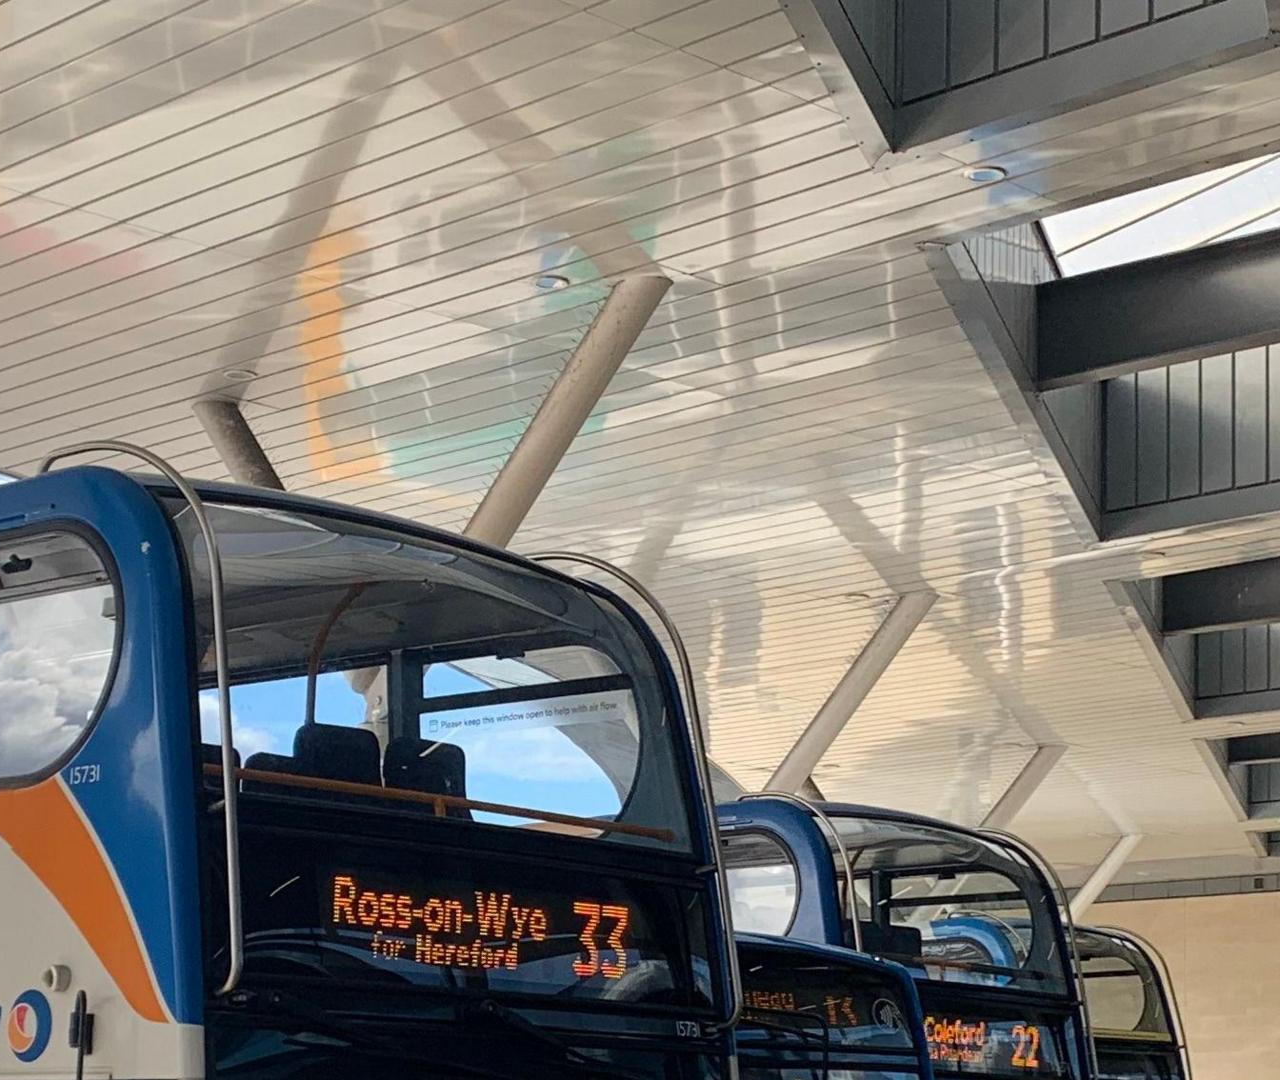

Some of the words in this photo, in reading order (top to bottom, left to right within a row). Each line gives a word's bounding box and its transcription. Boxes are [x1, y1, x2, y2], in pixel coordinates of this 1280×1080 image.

[464, 717, 481, 727] keep
[482, 715, 495, 725] this
[496, 711, 525, 723] window
[525, 710, 544, 721] open
[545, 708, 553, 718] to
[554, 704, 570, 717] help
[570, 703, 588, 715] with
[69, 764, 100, 785] 15731
[332, 875, 548, 942] Ross-on-Wye
[572, 901, 629, 979] 33
[371, 930, 407, 961] for
[415, 933, 518, 970] Hereford
[923, 1015, 985, 1046] Coleford
[1011, 1024, 1039, 1068] 22
